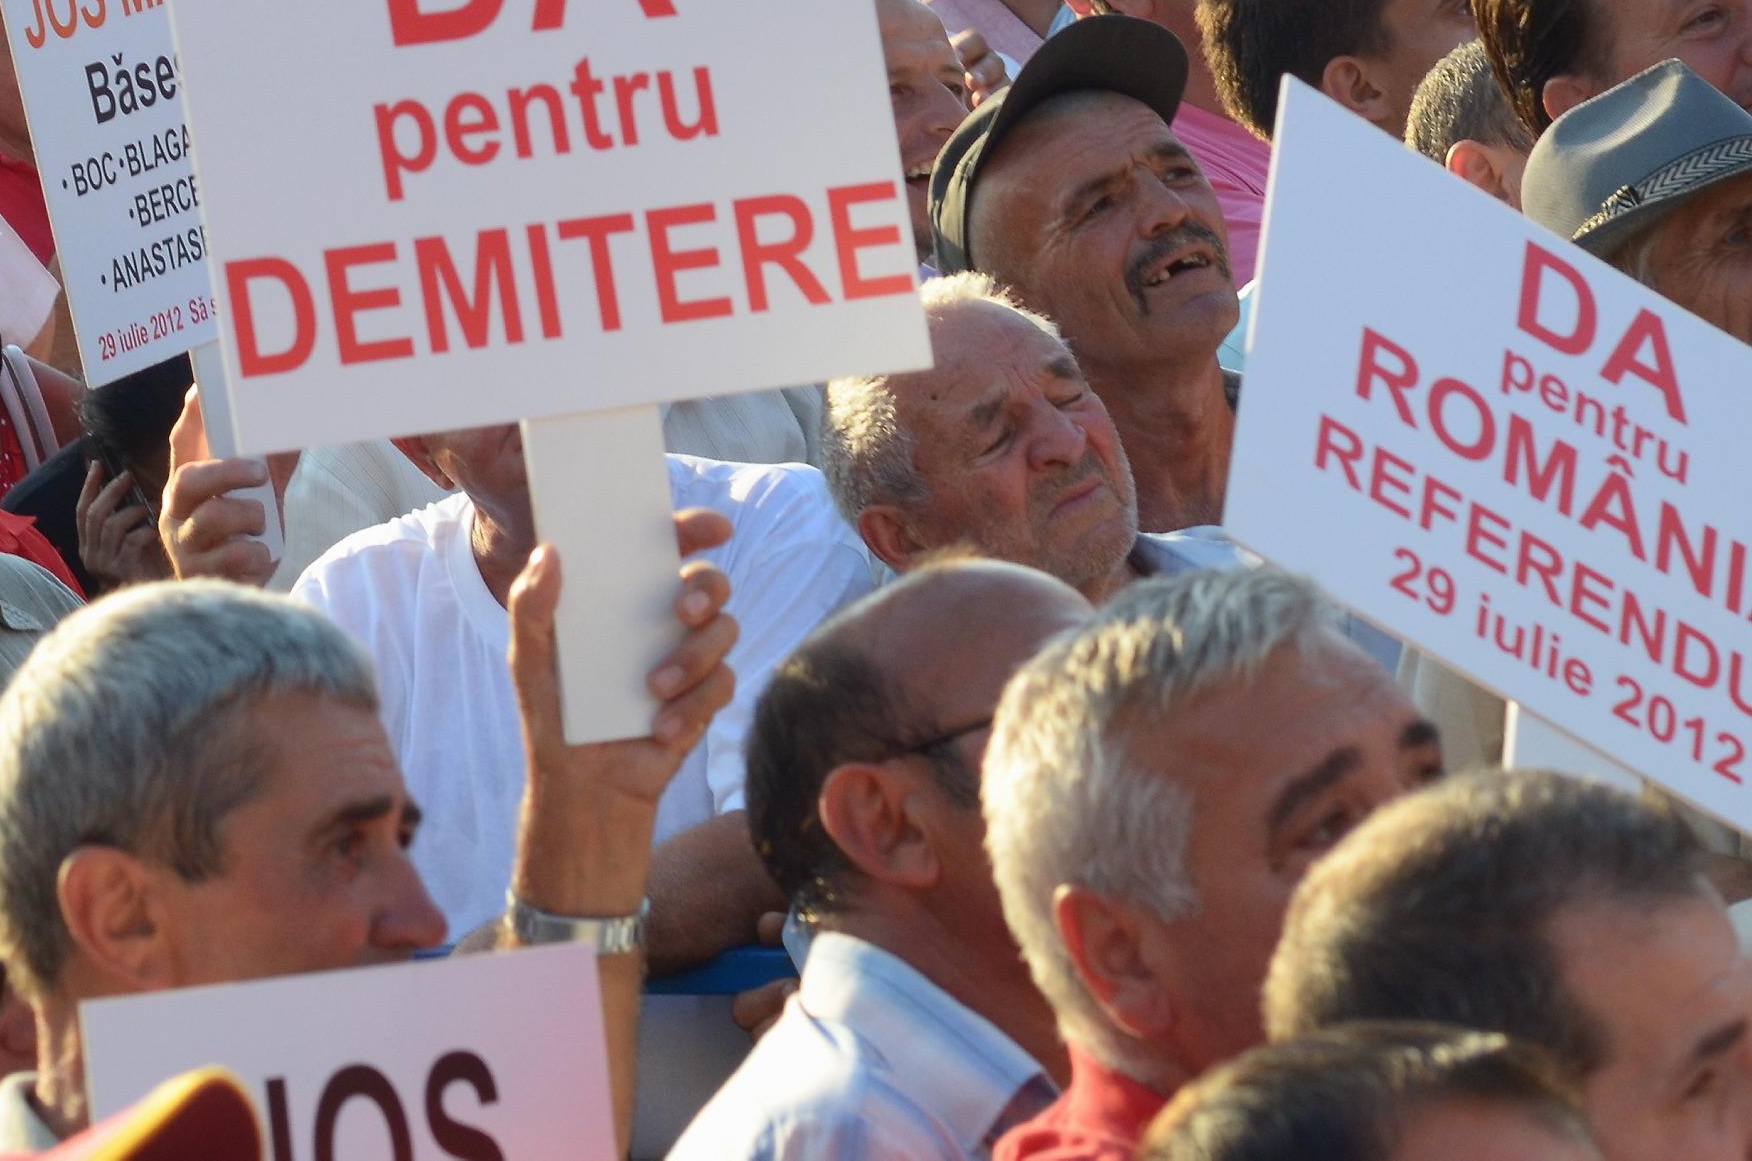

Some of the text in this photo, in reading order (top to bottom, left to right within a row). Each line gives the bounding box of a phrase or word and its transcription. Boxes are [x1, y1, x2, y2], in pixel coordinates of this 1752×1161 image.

[85, 52, 184, 125] Băse
[373, 55, 721, 202] pentru
[71, 151, 118, 197] BOC
[99, 331, 118, 362] 29
[118, 323, 149, 354] iulie
[150, 305, 185, 341] 2012
[189, 296, 209, 325] Să
[224, 180, 915, 379] DEMITERE
[1515, 238, 1689, 427] DA
[1355, 325, 1752, 624] ROMÂNI
[1500, 347, 1691, 487] pentru
[1389, 546, 1745, 786] 29 iulie 2012
